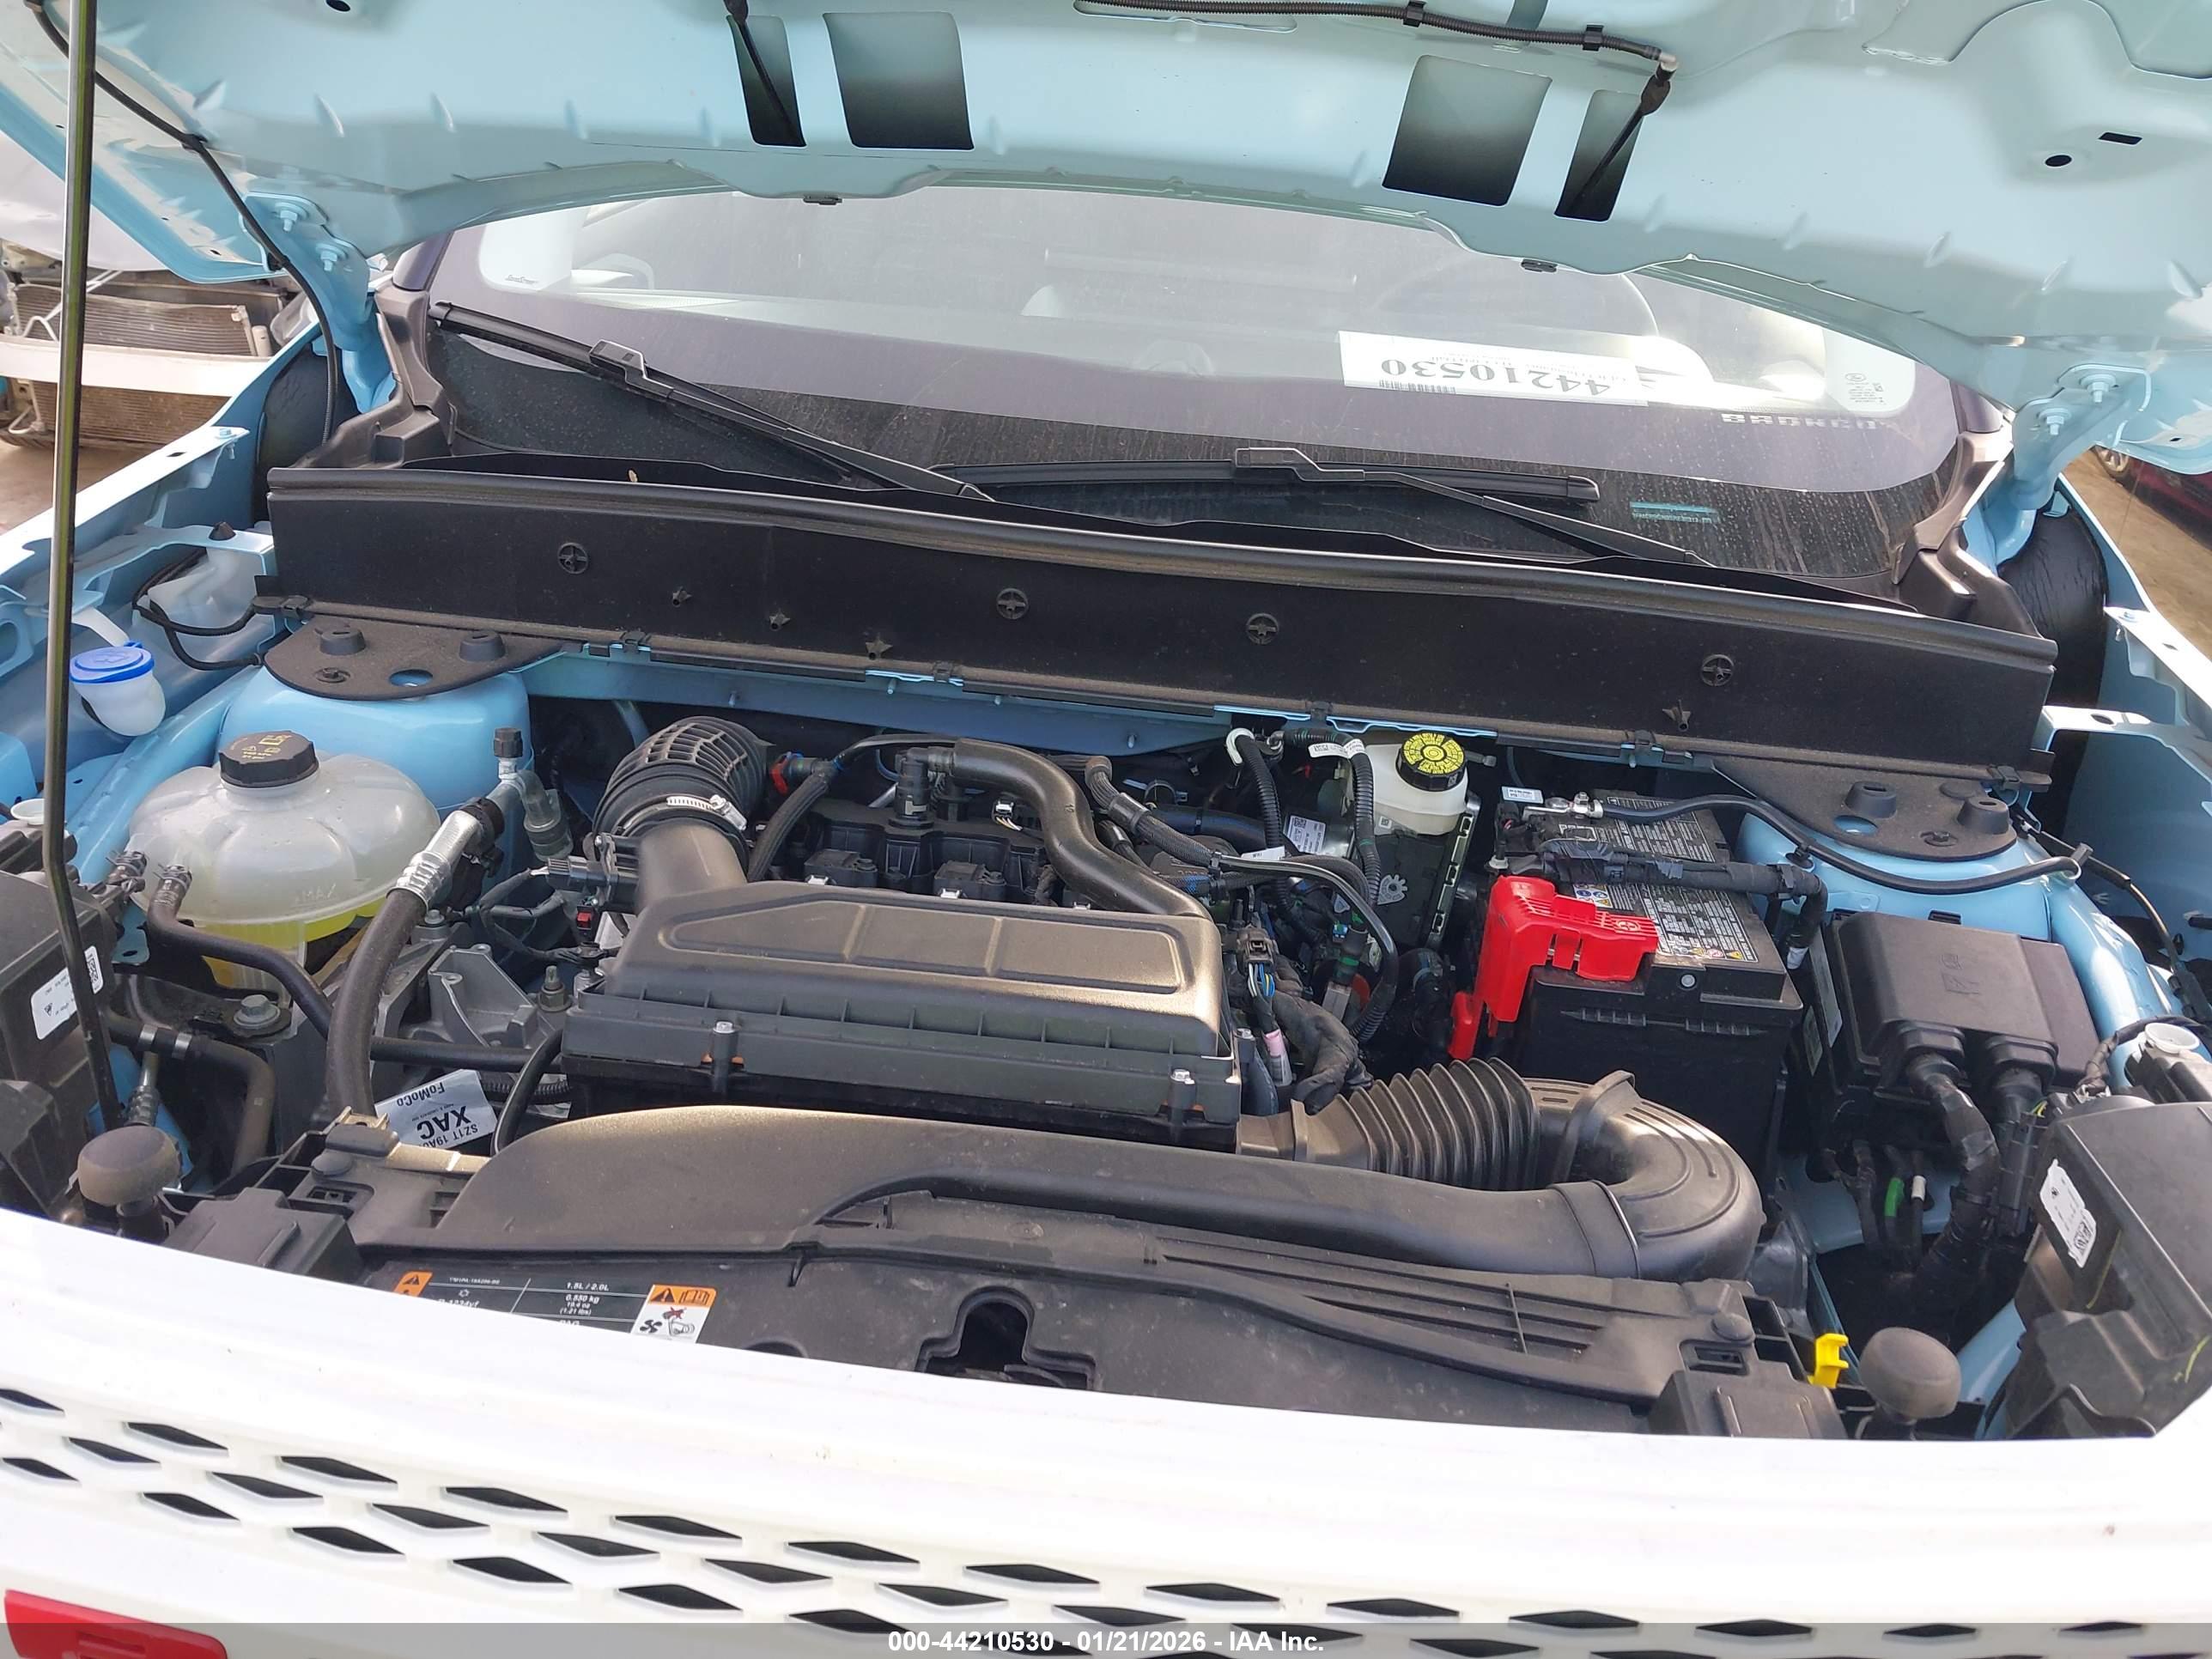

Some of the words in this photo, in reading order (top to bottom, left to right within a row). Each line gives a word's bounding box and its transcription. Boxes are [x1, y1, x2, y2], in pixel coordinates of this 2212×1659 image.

[1380, 358, 1611, 396] 44210530
[397, 1082, 446, 1107] FoMoCo
[416, 1105, 471, 1140] XAC
[453, 1124, 478, 1140] SZ1T
[591, 1283, 610, 1291] 2.0L
